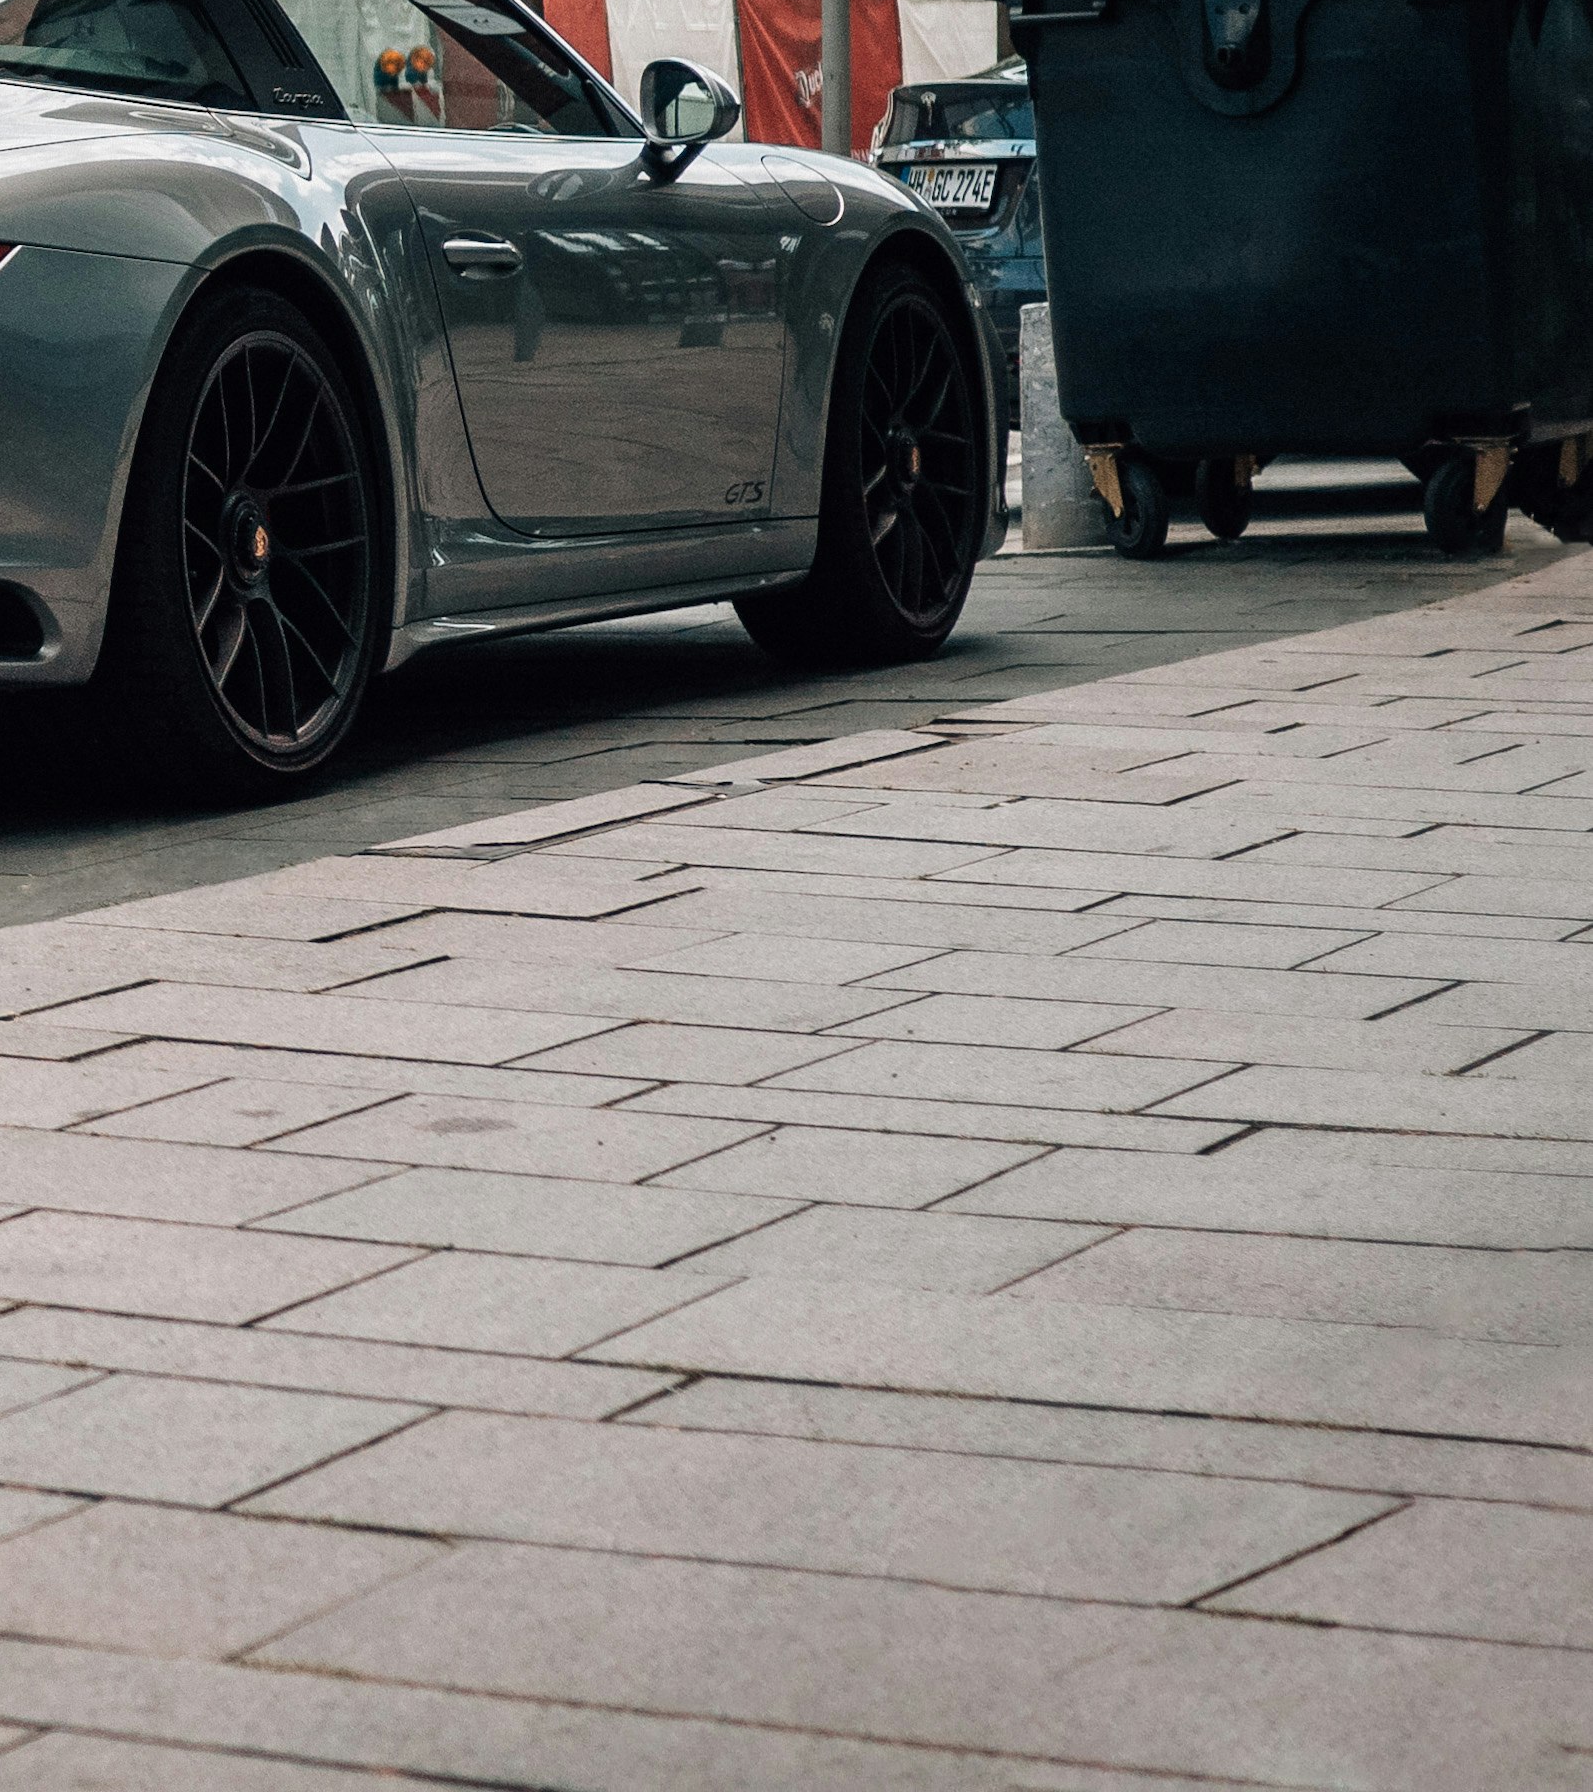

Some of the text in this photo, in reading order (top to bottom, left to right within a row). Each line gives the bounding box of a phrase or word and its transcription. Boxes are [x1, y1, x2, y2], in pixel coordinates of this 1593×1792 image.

[932, 168, 954, 202] GC
[953, 168, 995, 203] 274E
[725, 480, 767, 504] GTS
